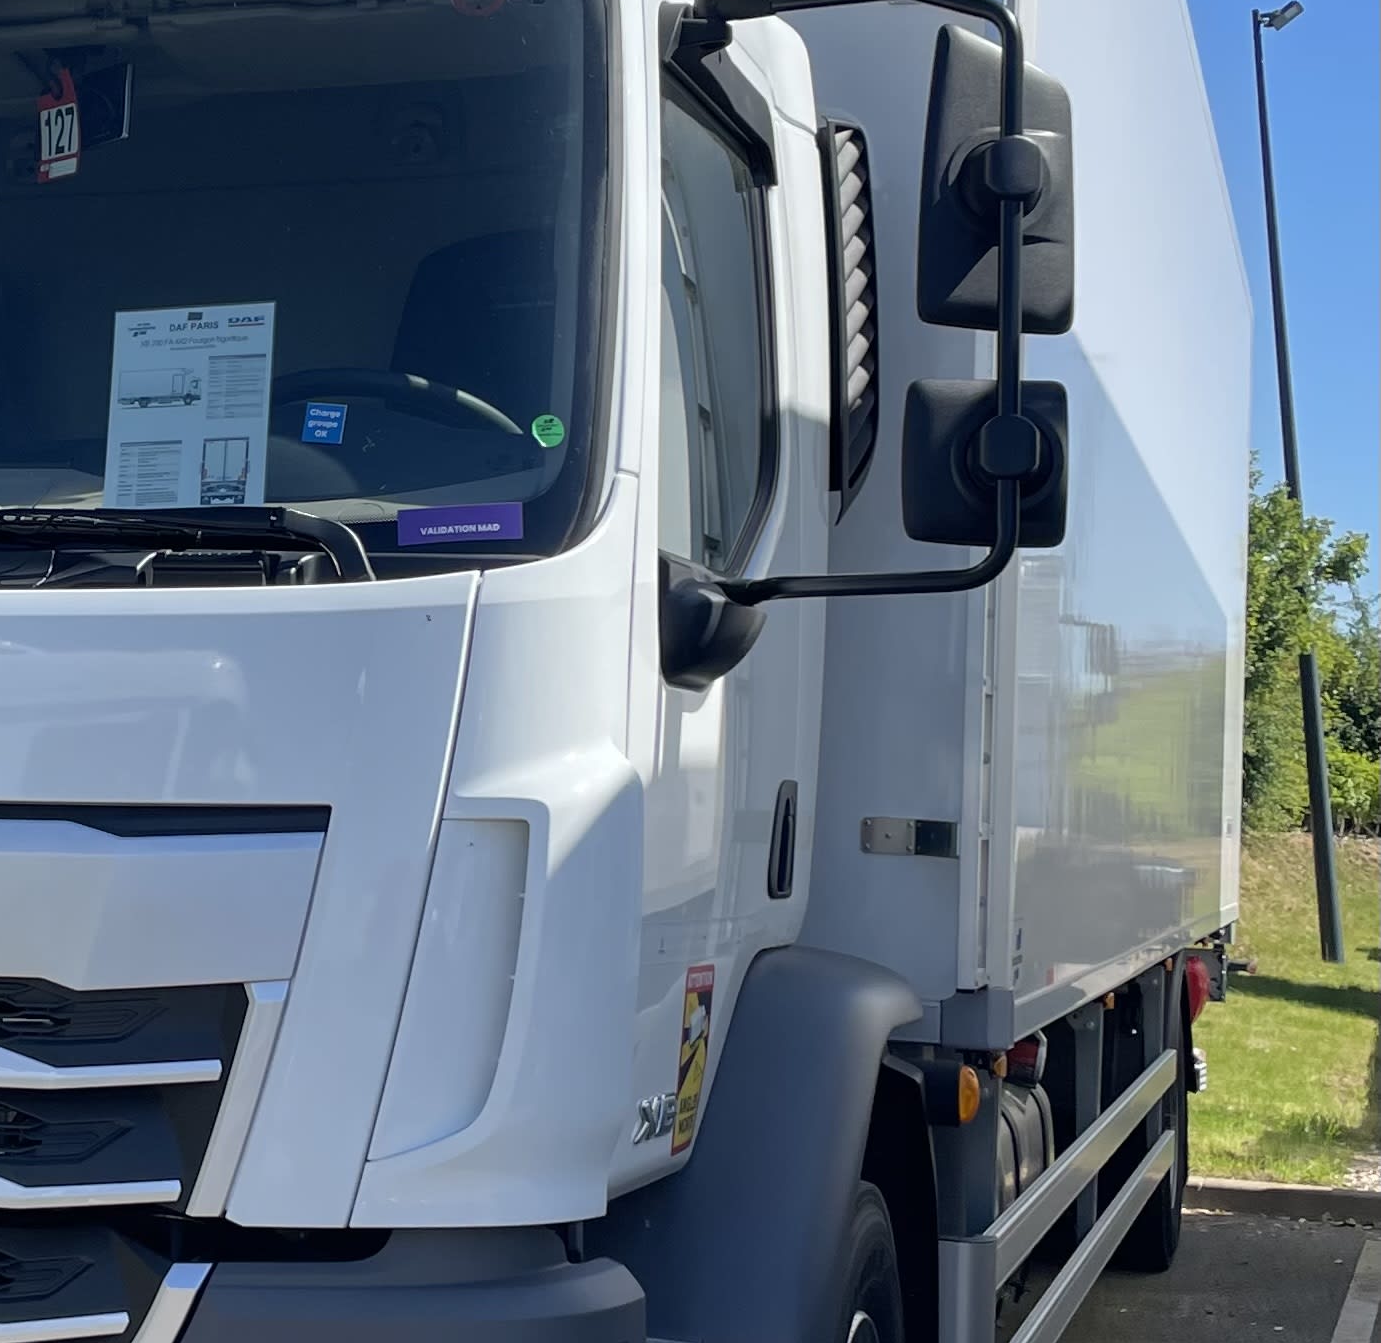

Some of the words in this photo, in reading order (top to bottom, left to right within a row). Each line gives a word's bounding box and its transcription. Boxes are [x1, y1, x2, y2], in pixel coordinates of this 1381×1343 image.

[45, 106, 75, 156] 127
[228, 315, 265, 324] DAF
[169, 323, 188, 332] DAF
[190, 321, 218, 330] PARIS
[310, 409, 340, 419] Charge
[314, 429, 327, 437] OK
[420, 524, 476, 535] VALIDATION
[478, 523, 500, 532] MAD
